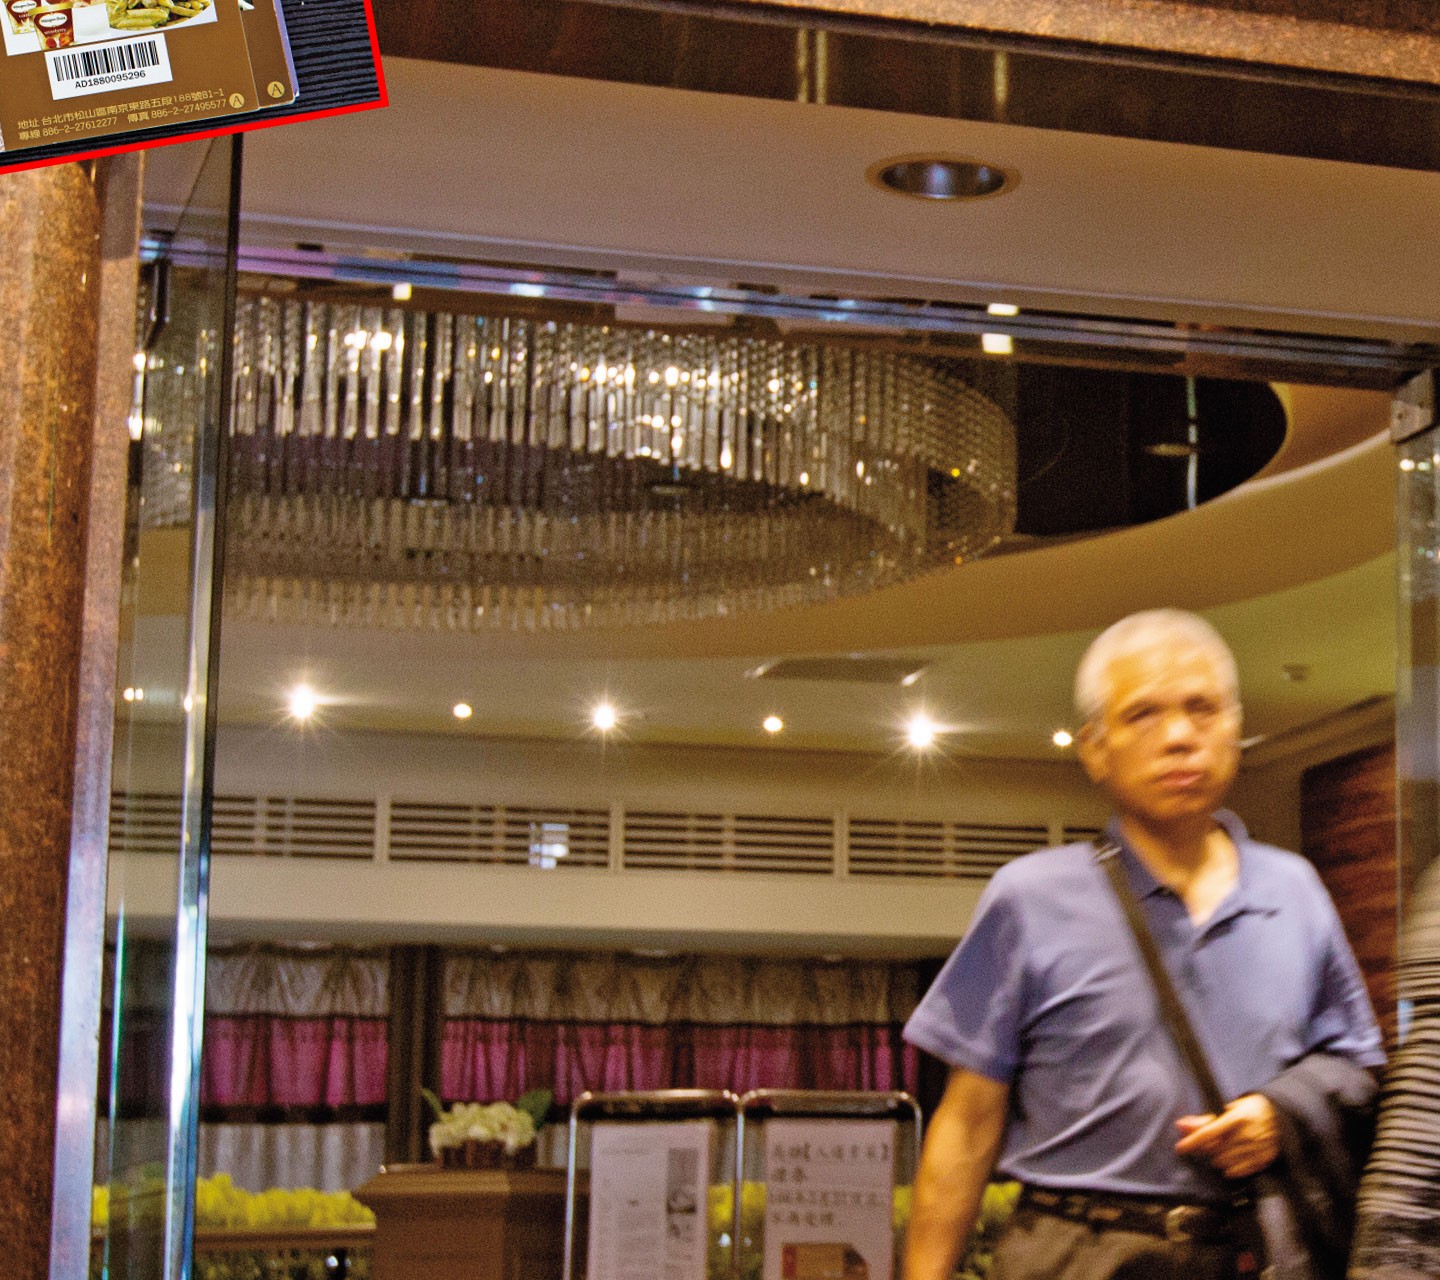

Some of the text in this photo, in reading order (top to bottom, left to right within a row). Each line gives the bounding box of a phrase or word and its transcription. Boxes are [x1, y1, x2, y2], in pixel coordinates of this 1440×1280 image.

[73, 69, 147, 89] AD1880095296
[16, 117, 40, 130] 地址
[18, 98, 227, 141] 專線 886-2-27612277 傳真 886-2-27495577
